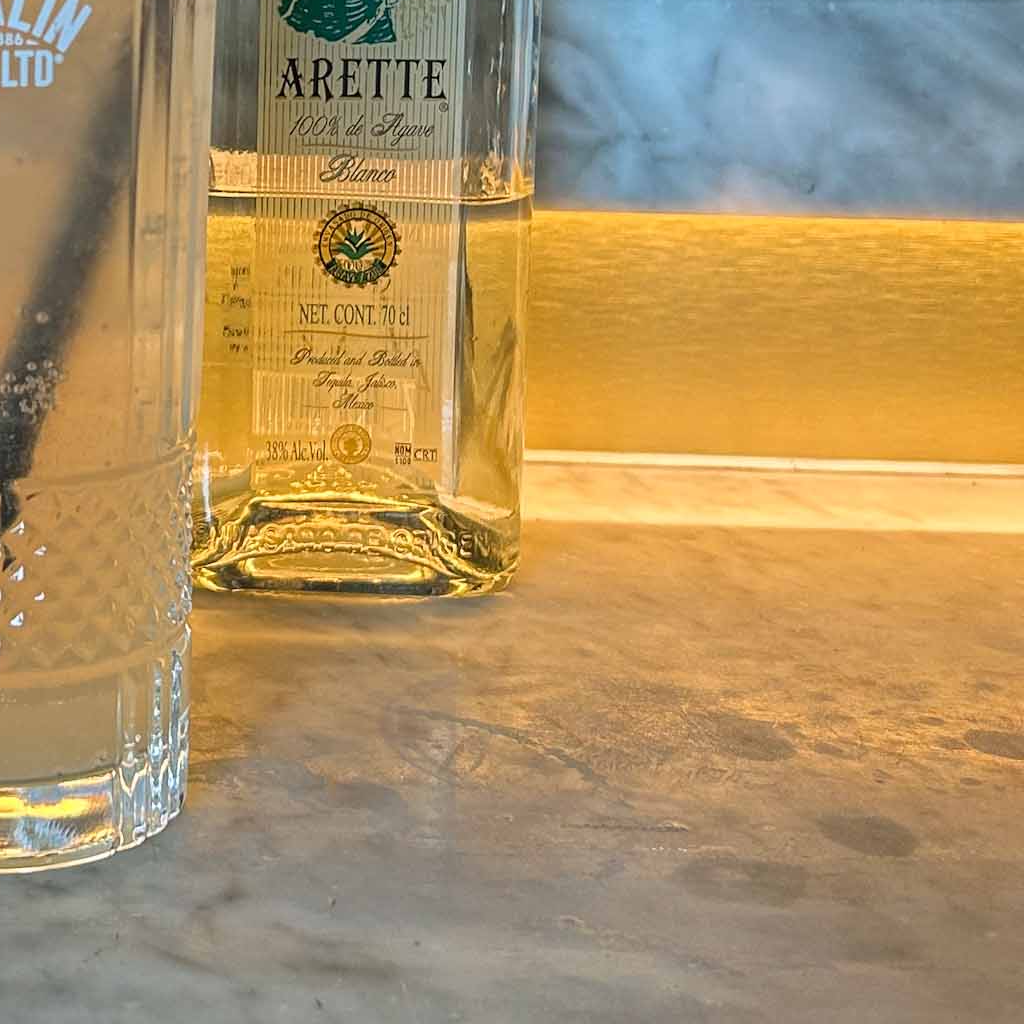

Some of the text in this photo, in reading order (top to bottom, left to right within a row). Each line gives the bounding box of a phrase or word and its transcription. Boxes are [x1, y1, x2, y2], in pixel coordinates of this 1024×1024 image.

[276, 57, 447, 104] ARETTE
[289, 112, 434, 147] 100% de Agave
[320, 153, 397, 183] Blanco
[299, 303, 410, 326] NET. CONT. 70 cl
[290, 346, 346, 366] Produced
[344, 352, 367, 366] and
[368, 349, 411, 367] Bottled
